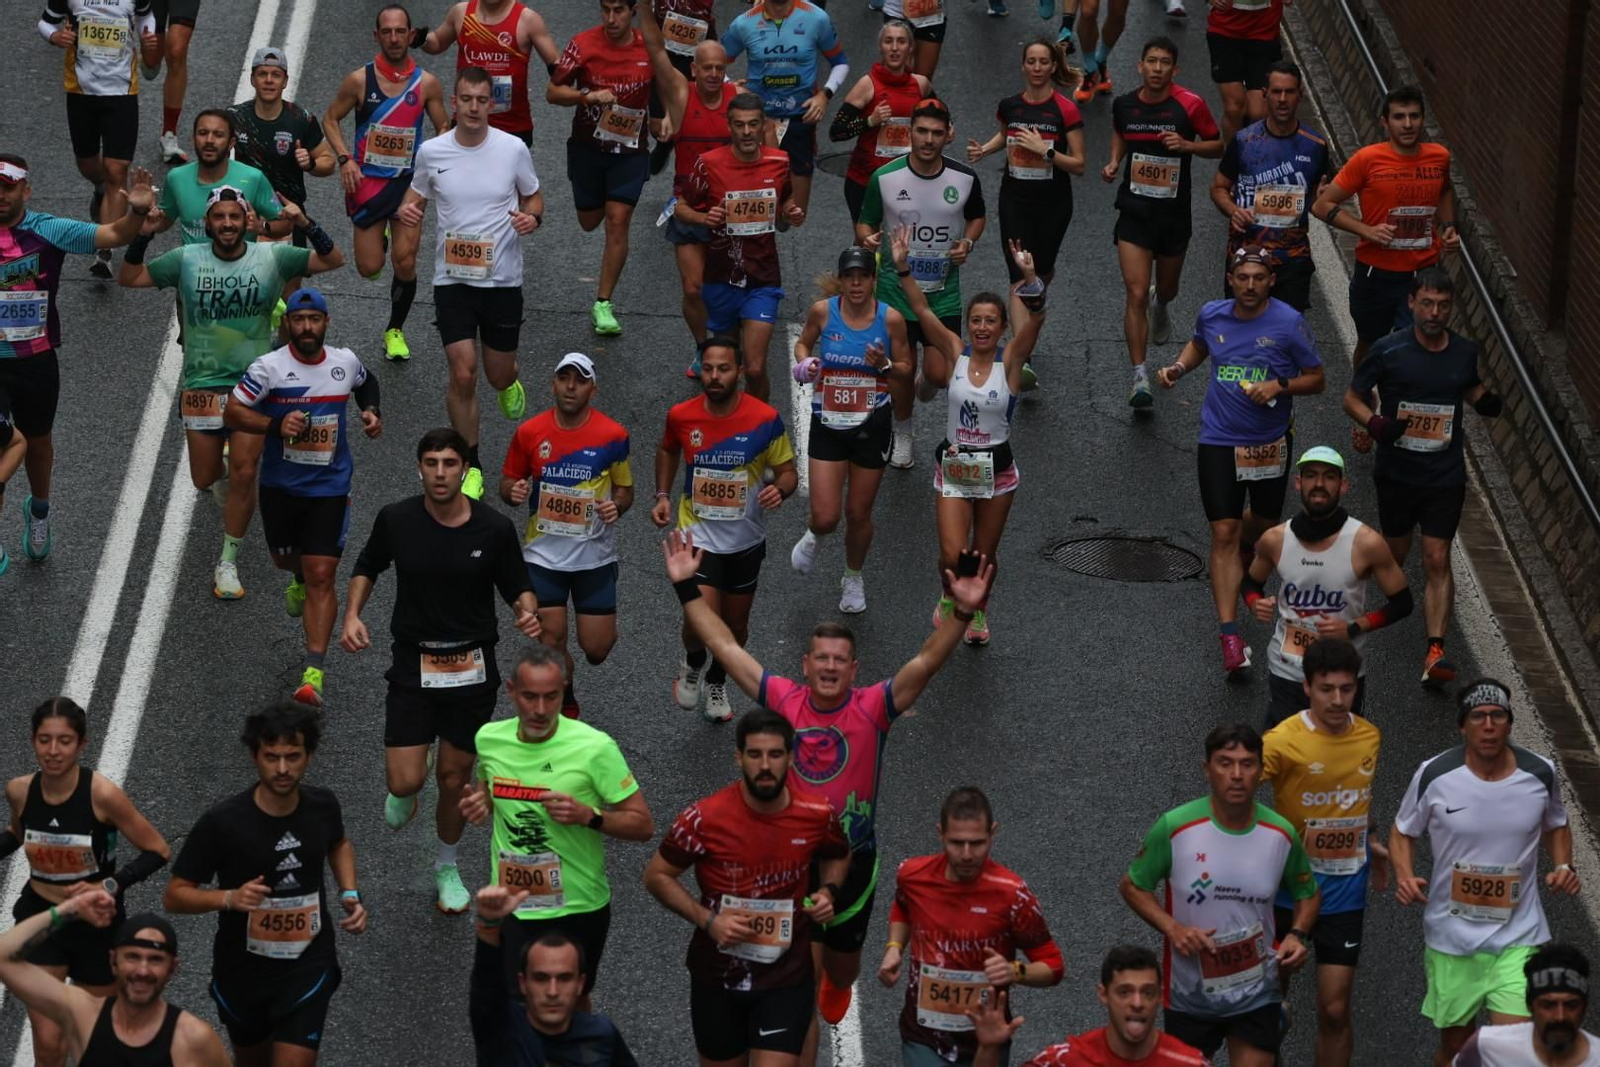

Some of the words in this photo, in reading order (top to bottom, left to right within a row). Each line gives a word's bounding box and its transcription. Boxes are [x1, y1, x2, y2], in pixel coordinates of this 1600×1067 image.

[83, 25, 120, 41] 13675
[669, 23, 696, 39] 4236
[471, 50, 510, 62] LAWDE
[608, 114, 637, 131] 5947
[375, 136, 404, 150] 5263
[1137, 164, 1168, 180] 4501
[734, 200, 766, 218] 4746
[1262, 193, 1293, 209] 5986
[451, 242, 482, 259] 4539
[197, 273, 261, 290] IBHOLA
[195, 287, 264, 309] TRAIL
[201, 306, 261, 321] RUNNING
[1217, 365, 1267, 382] BERLIN
[185, 394, 215, 409] 4897
[834, 389, 859, 404] 581
[1406, 414, 1440, 431] 5787
[694, 453, 746, 466] PALACIEGO
[1243, 445, 1277, 460] 3552
[541, 464, 592, 481] PALACIEGO
[948, 464, 982, 479] 6812
[700, 482, 736, 500] 4885
[546, 497, 582, 516] 4886
[1284, 582, 1346, 609] Cuba
[1315, 832, 1355, 850] 6299
[506, 867, 544, 888] 5200
[1461, 876, 1505, 898] 5928
[260, 912, 306, 933] 4556
[929, 983, 973, 1005] 5417
